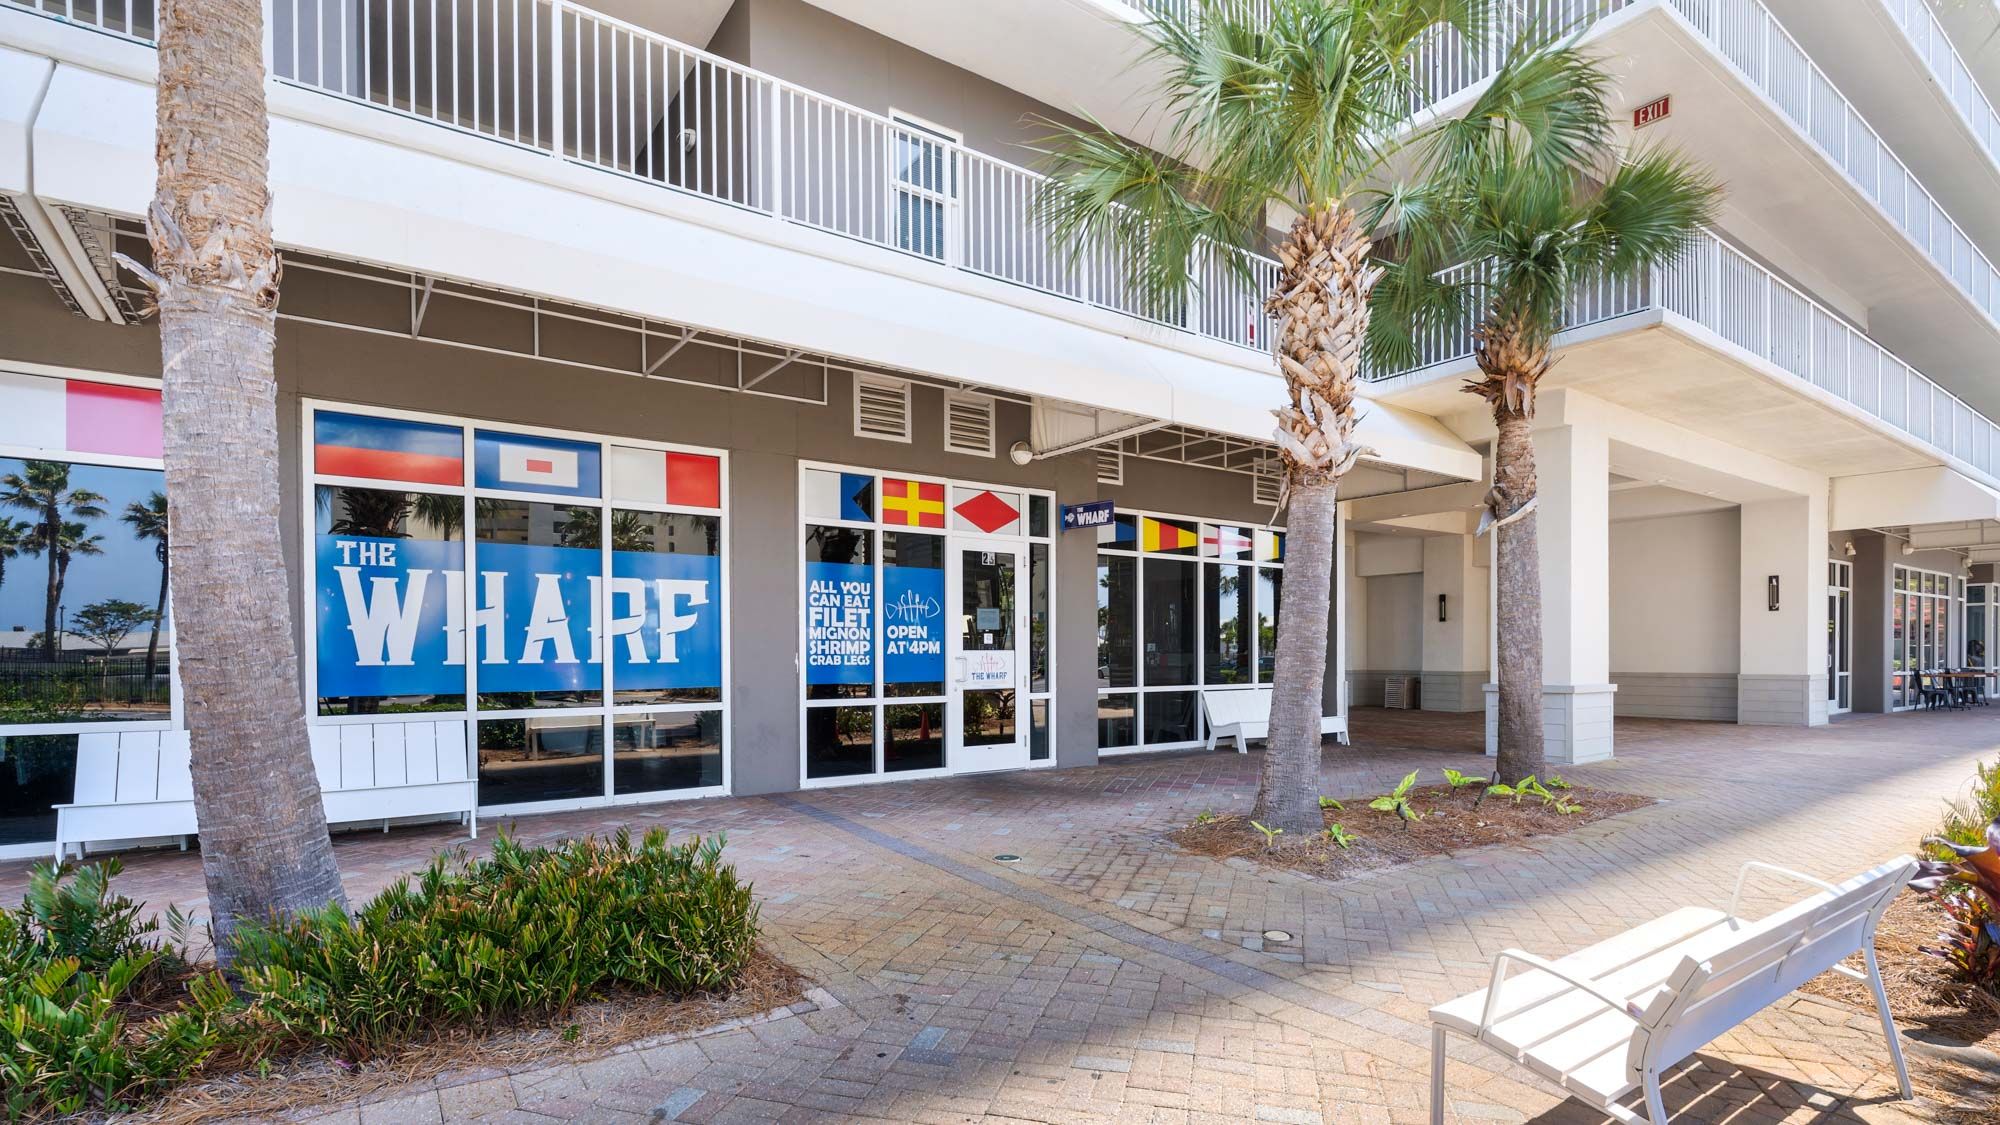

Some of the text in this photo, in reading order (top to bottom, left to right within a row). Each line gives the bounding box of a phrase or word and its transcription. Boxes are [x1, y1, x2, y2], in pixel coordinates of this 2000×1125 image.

[1640, 101, 1665, 124] EXIT
[1077, 509, 1109, 526] WHARF
[336, 541, 396, 566] THE
[809, 580, 871, 595] ALL YOU
[809, 594, 871, 608] CAN EAT
[333, 566, 709, 666] WHARF
[809, 606, 871, 628] FILET
[809, 627, 871, 641] MIGNON
[886, 625, 928, 639] OPEN
[809, 640, 871, 655] SHRIMP
[908, 640, 941, 654] 4PM
[809, 655, 871, 666] CRAB LEGS
[971, 671, 1008, 681] THE WHARF
